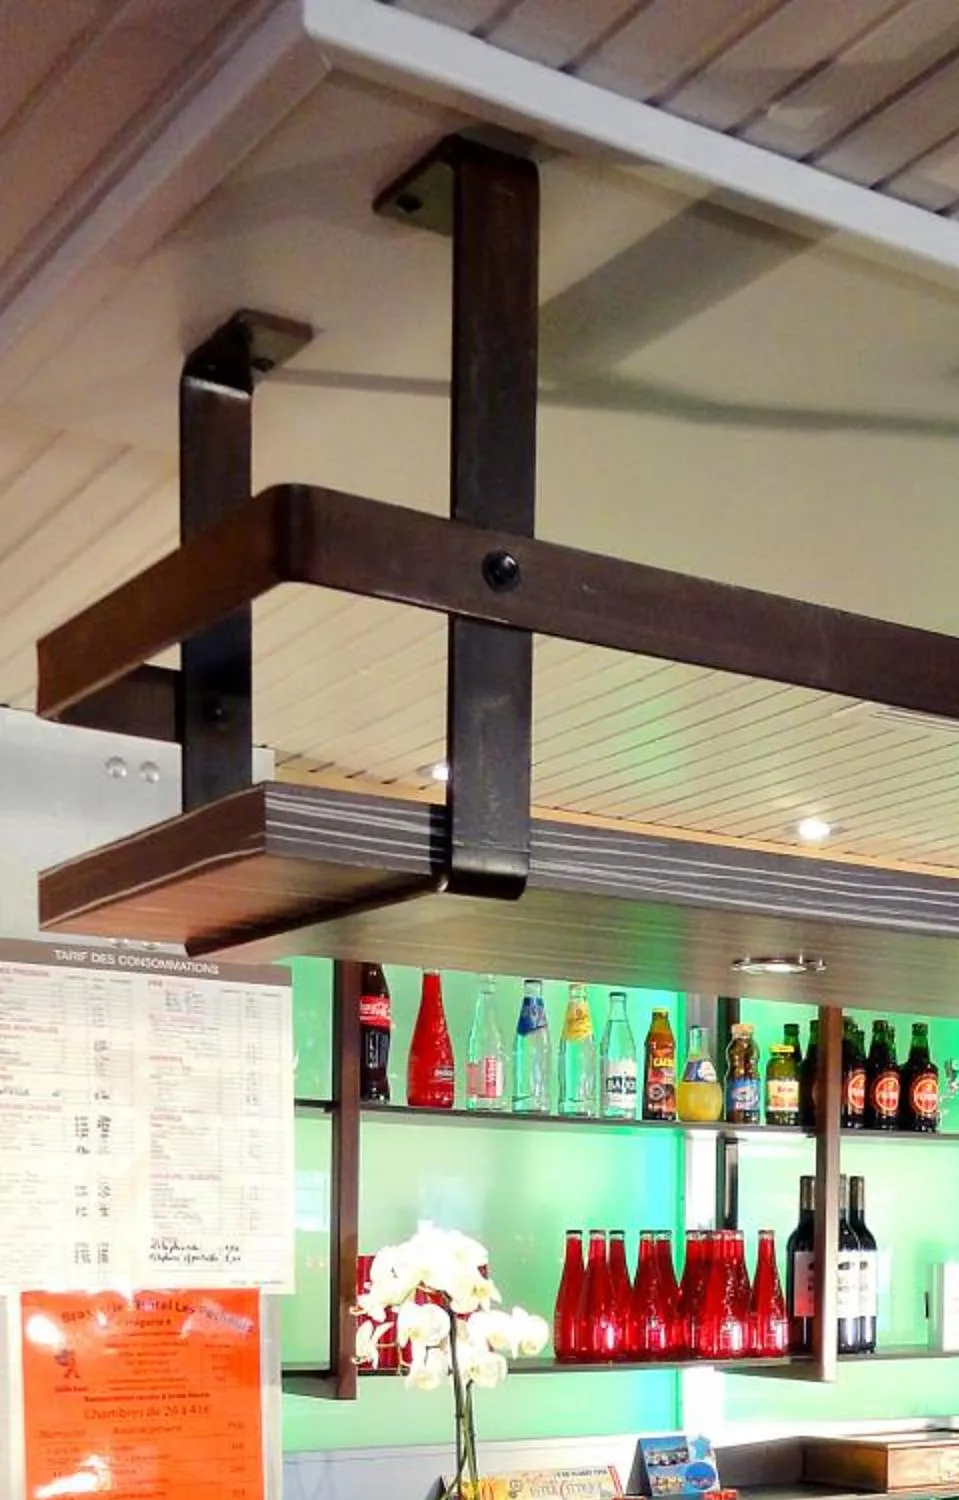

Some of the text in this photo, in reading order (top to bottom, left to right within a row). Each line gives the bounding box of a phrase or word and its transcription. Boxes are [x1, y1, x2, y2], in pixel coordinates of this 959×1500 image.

[54, 949, 219, 975] TARIF DES CONSOMMATIONS
